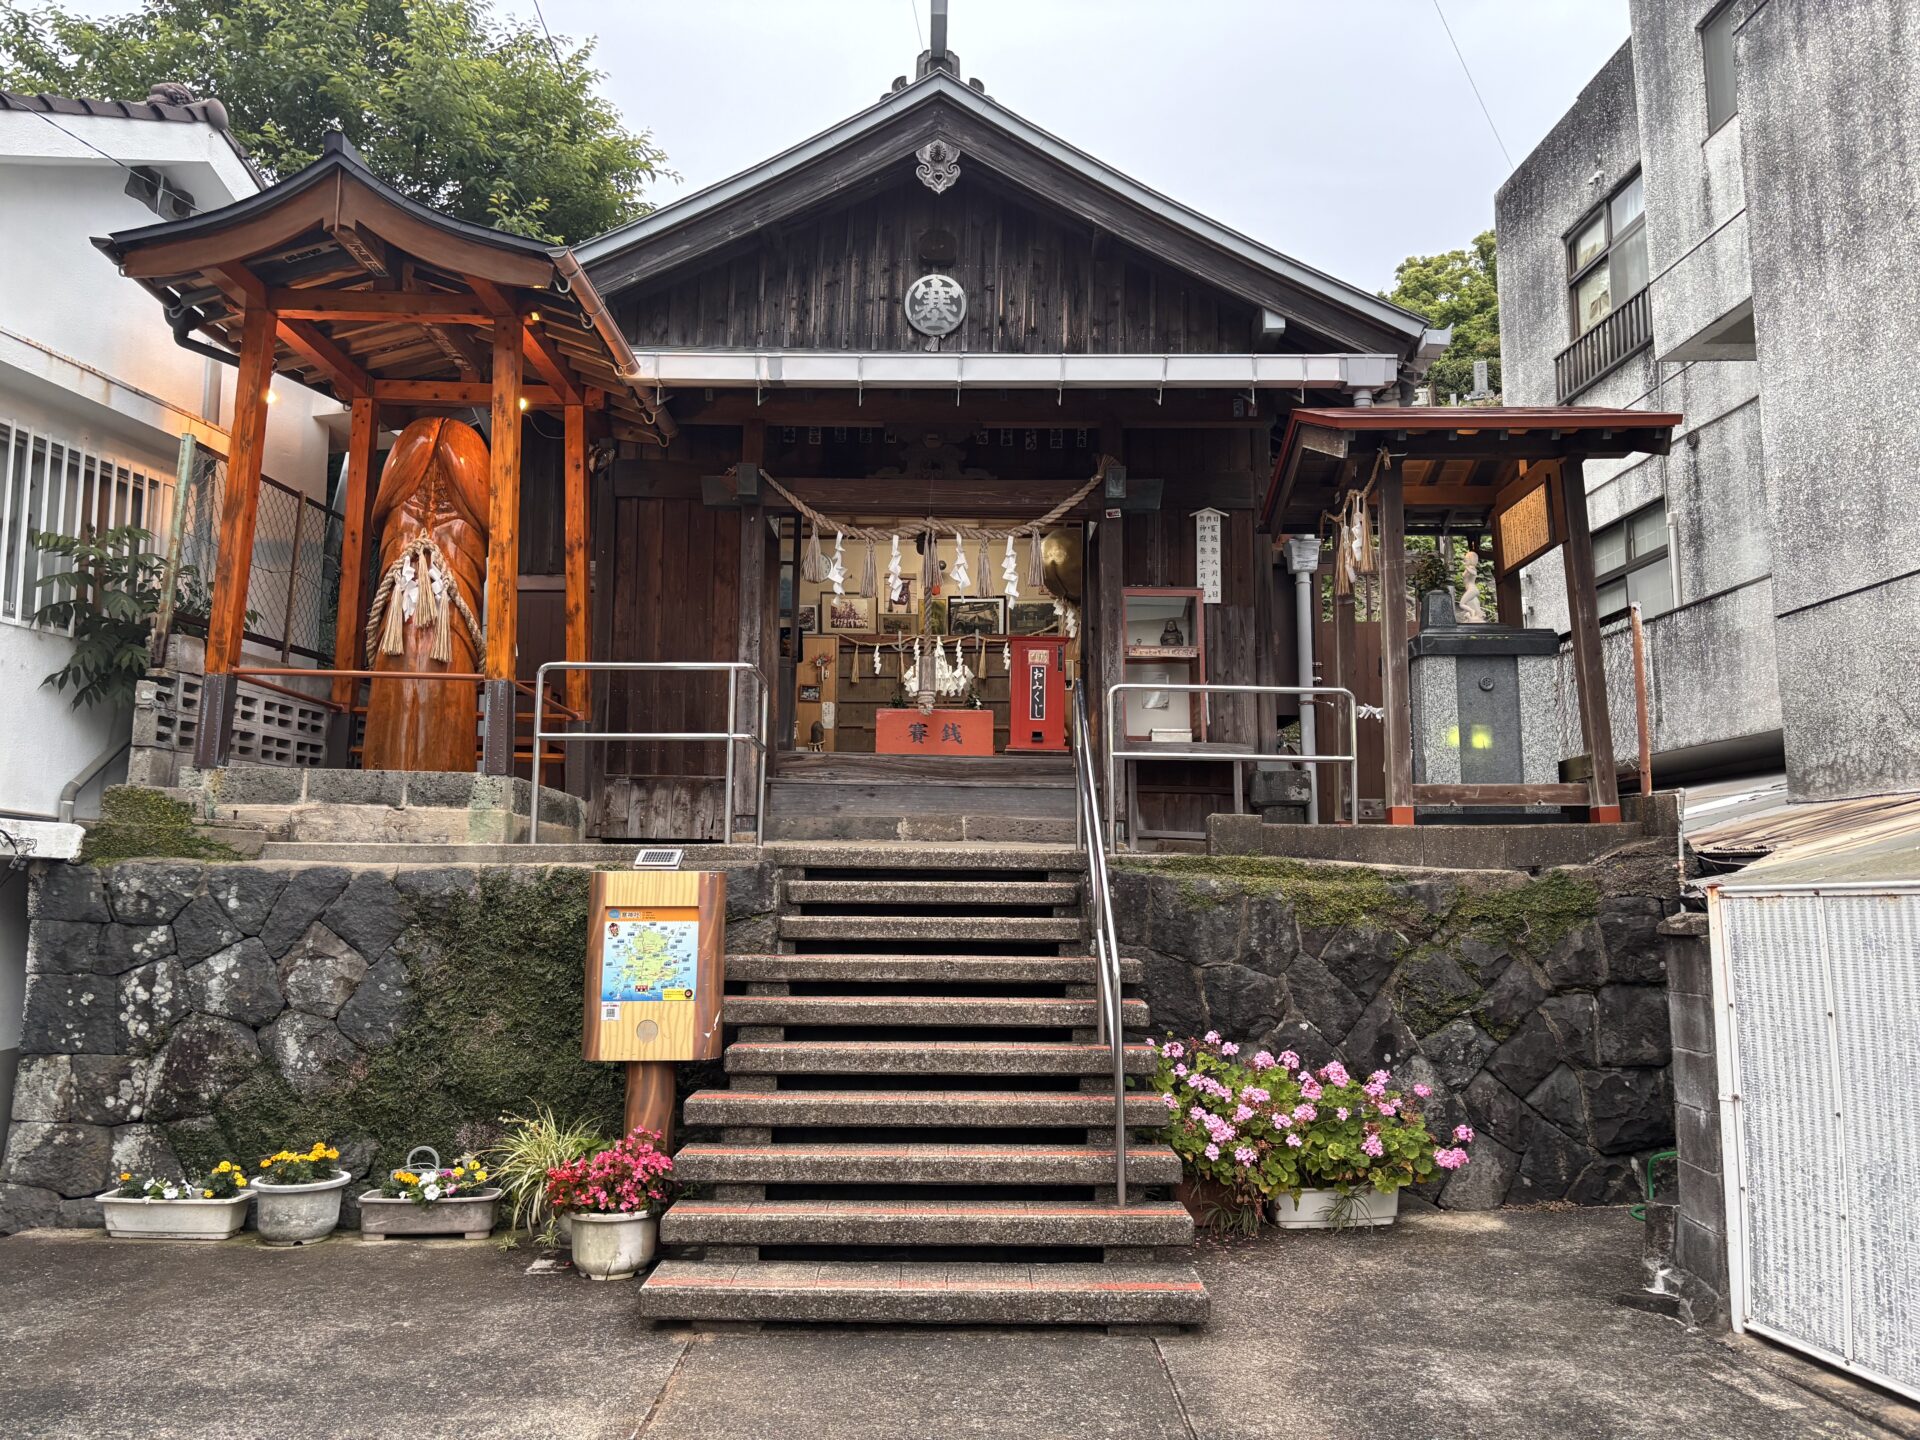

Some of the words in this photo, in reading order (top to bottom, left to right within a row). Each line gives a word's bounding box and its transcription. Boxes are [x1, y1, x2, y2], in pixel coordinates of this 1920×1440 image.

[1032, 667, 1044, 718] おみくじ
[908, 722, 963, 744] 賽銭
